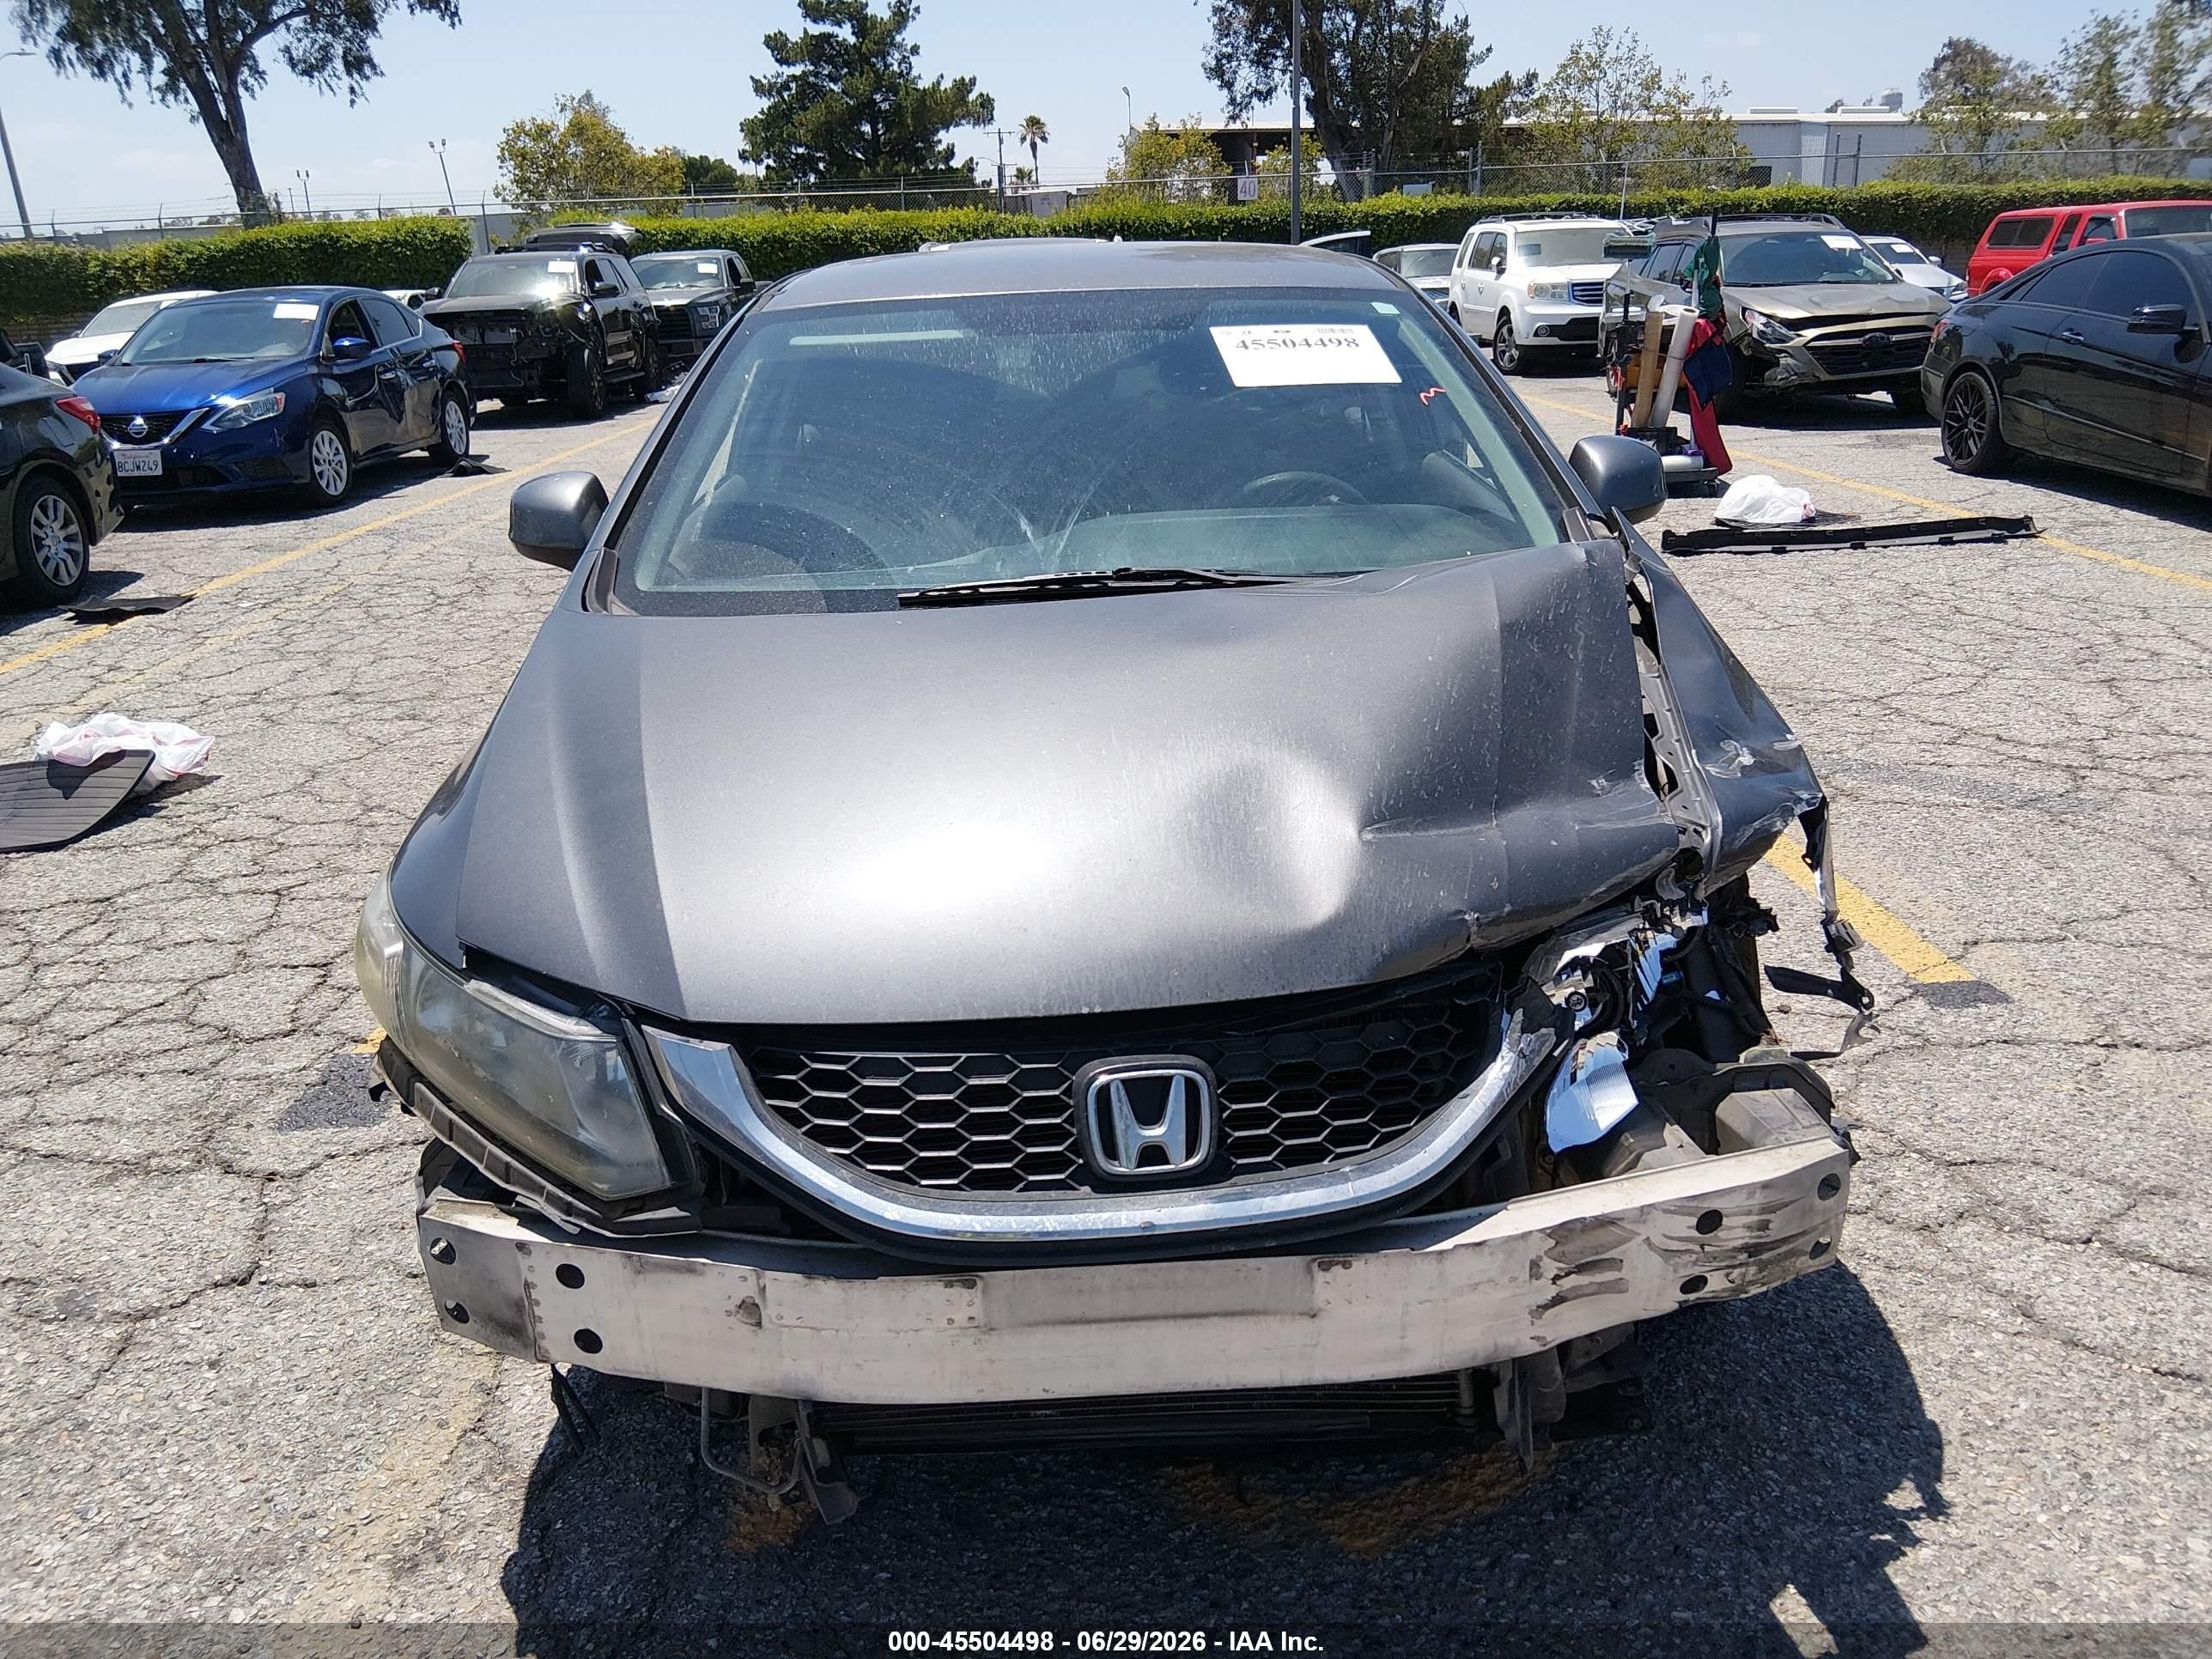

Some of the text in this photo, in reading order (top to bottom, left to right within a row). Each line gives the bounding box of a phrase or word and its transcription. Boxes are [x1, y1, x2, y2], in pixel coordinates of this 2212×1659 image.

[1240, 180, 1255, 198] 40
[1236, 337, 1359, 350] 45504498
[118, 460, 159, 472] 8CJW249
